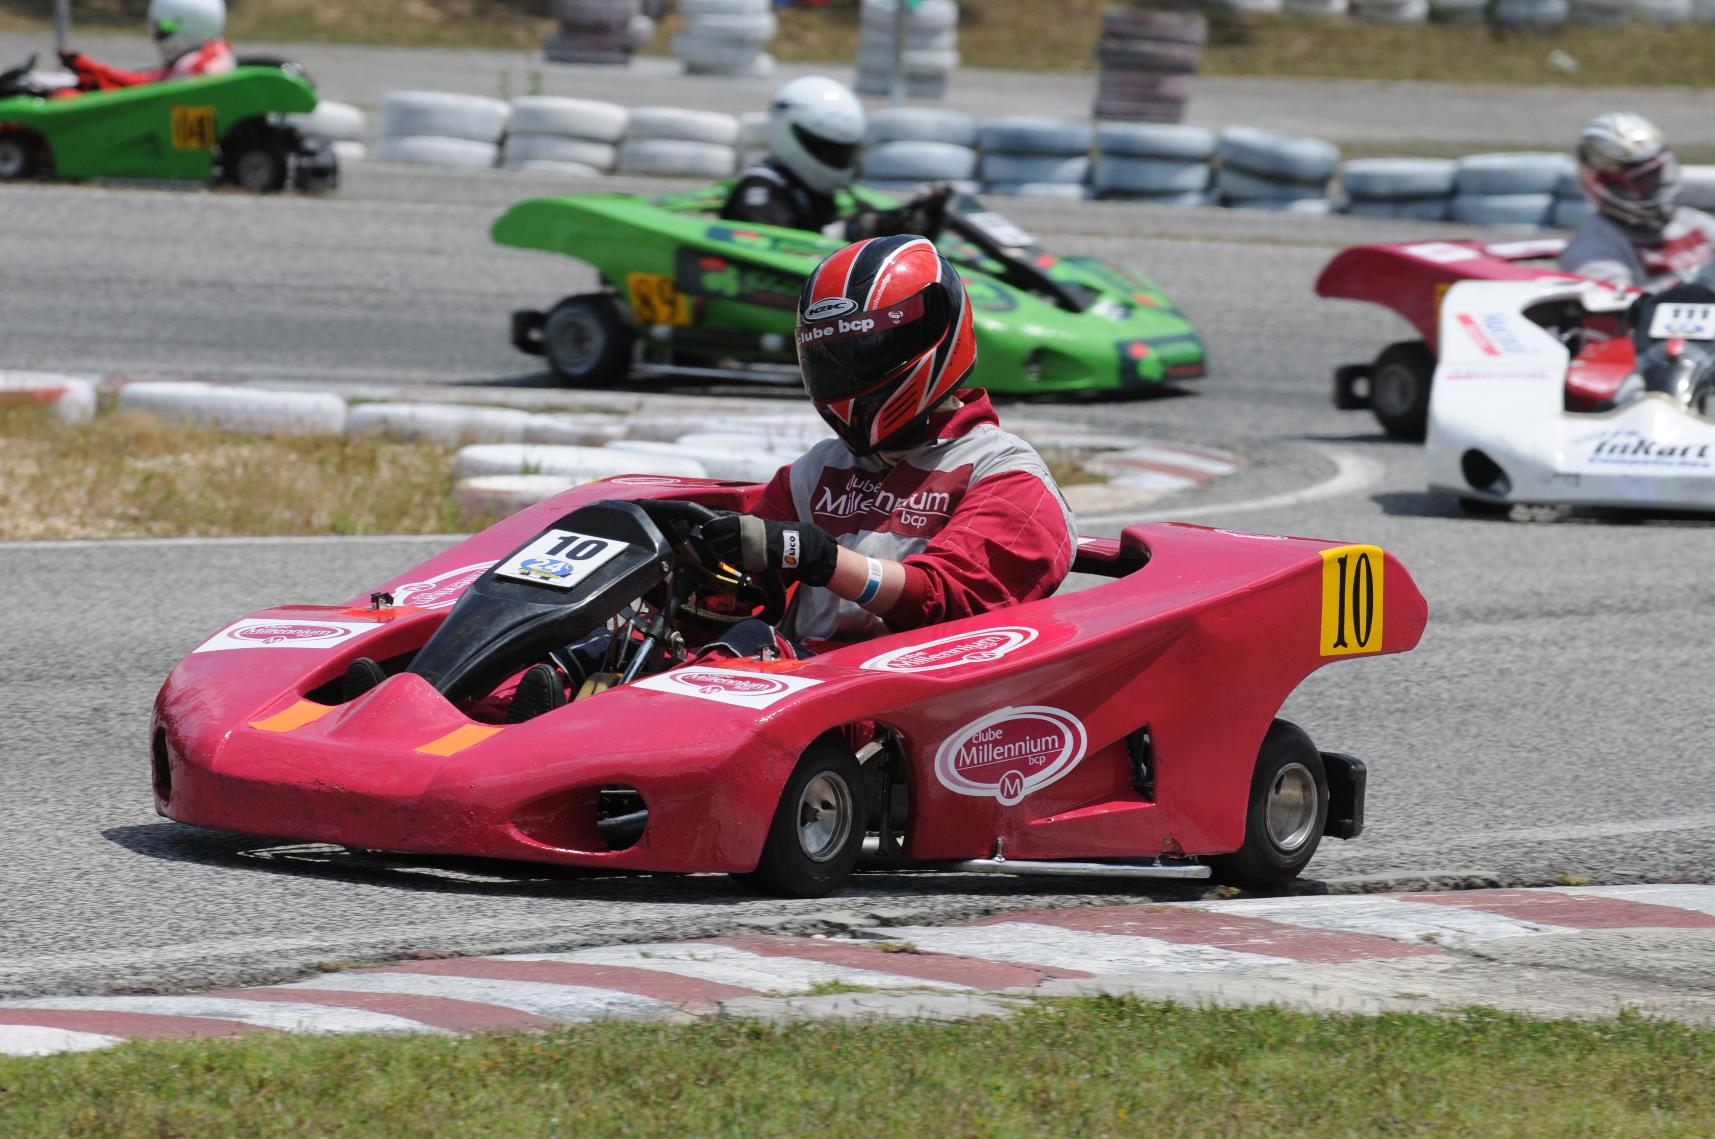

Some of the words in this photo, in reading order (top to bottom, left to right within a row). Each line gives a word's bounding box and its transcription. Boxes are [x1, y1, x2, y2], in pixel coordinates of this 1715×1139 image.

[838, 317, 875, 333] bcp
[846, 474, 883, 493] clube
[901, 510, 927, 529] bcp
[544, 535, 609, 561] 10
[1333, 552, 1374, 649] 10
[240, 623, 332, 635] Millennium
[887, 635, 1004, 668] Millennium
[686, 673, 771, 691] Millennium
[972, 728, 1004, 744] clube
[958, 734, 1059, 768] Millennium
[1028, 754, 1046, 766] bcp
[1003, 777, 1021, 797] M
